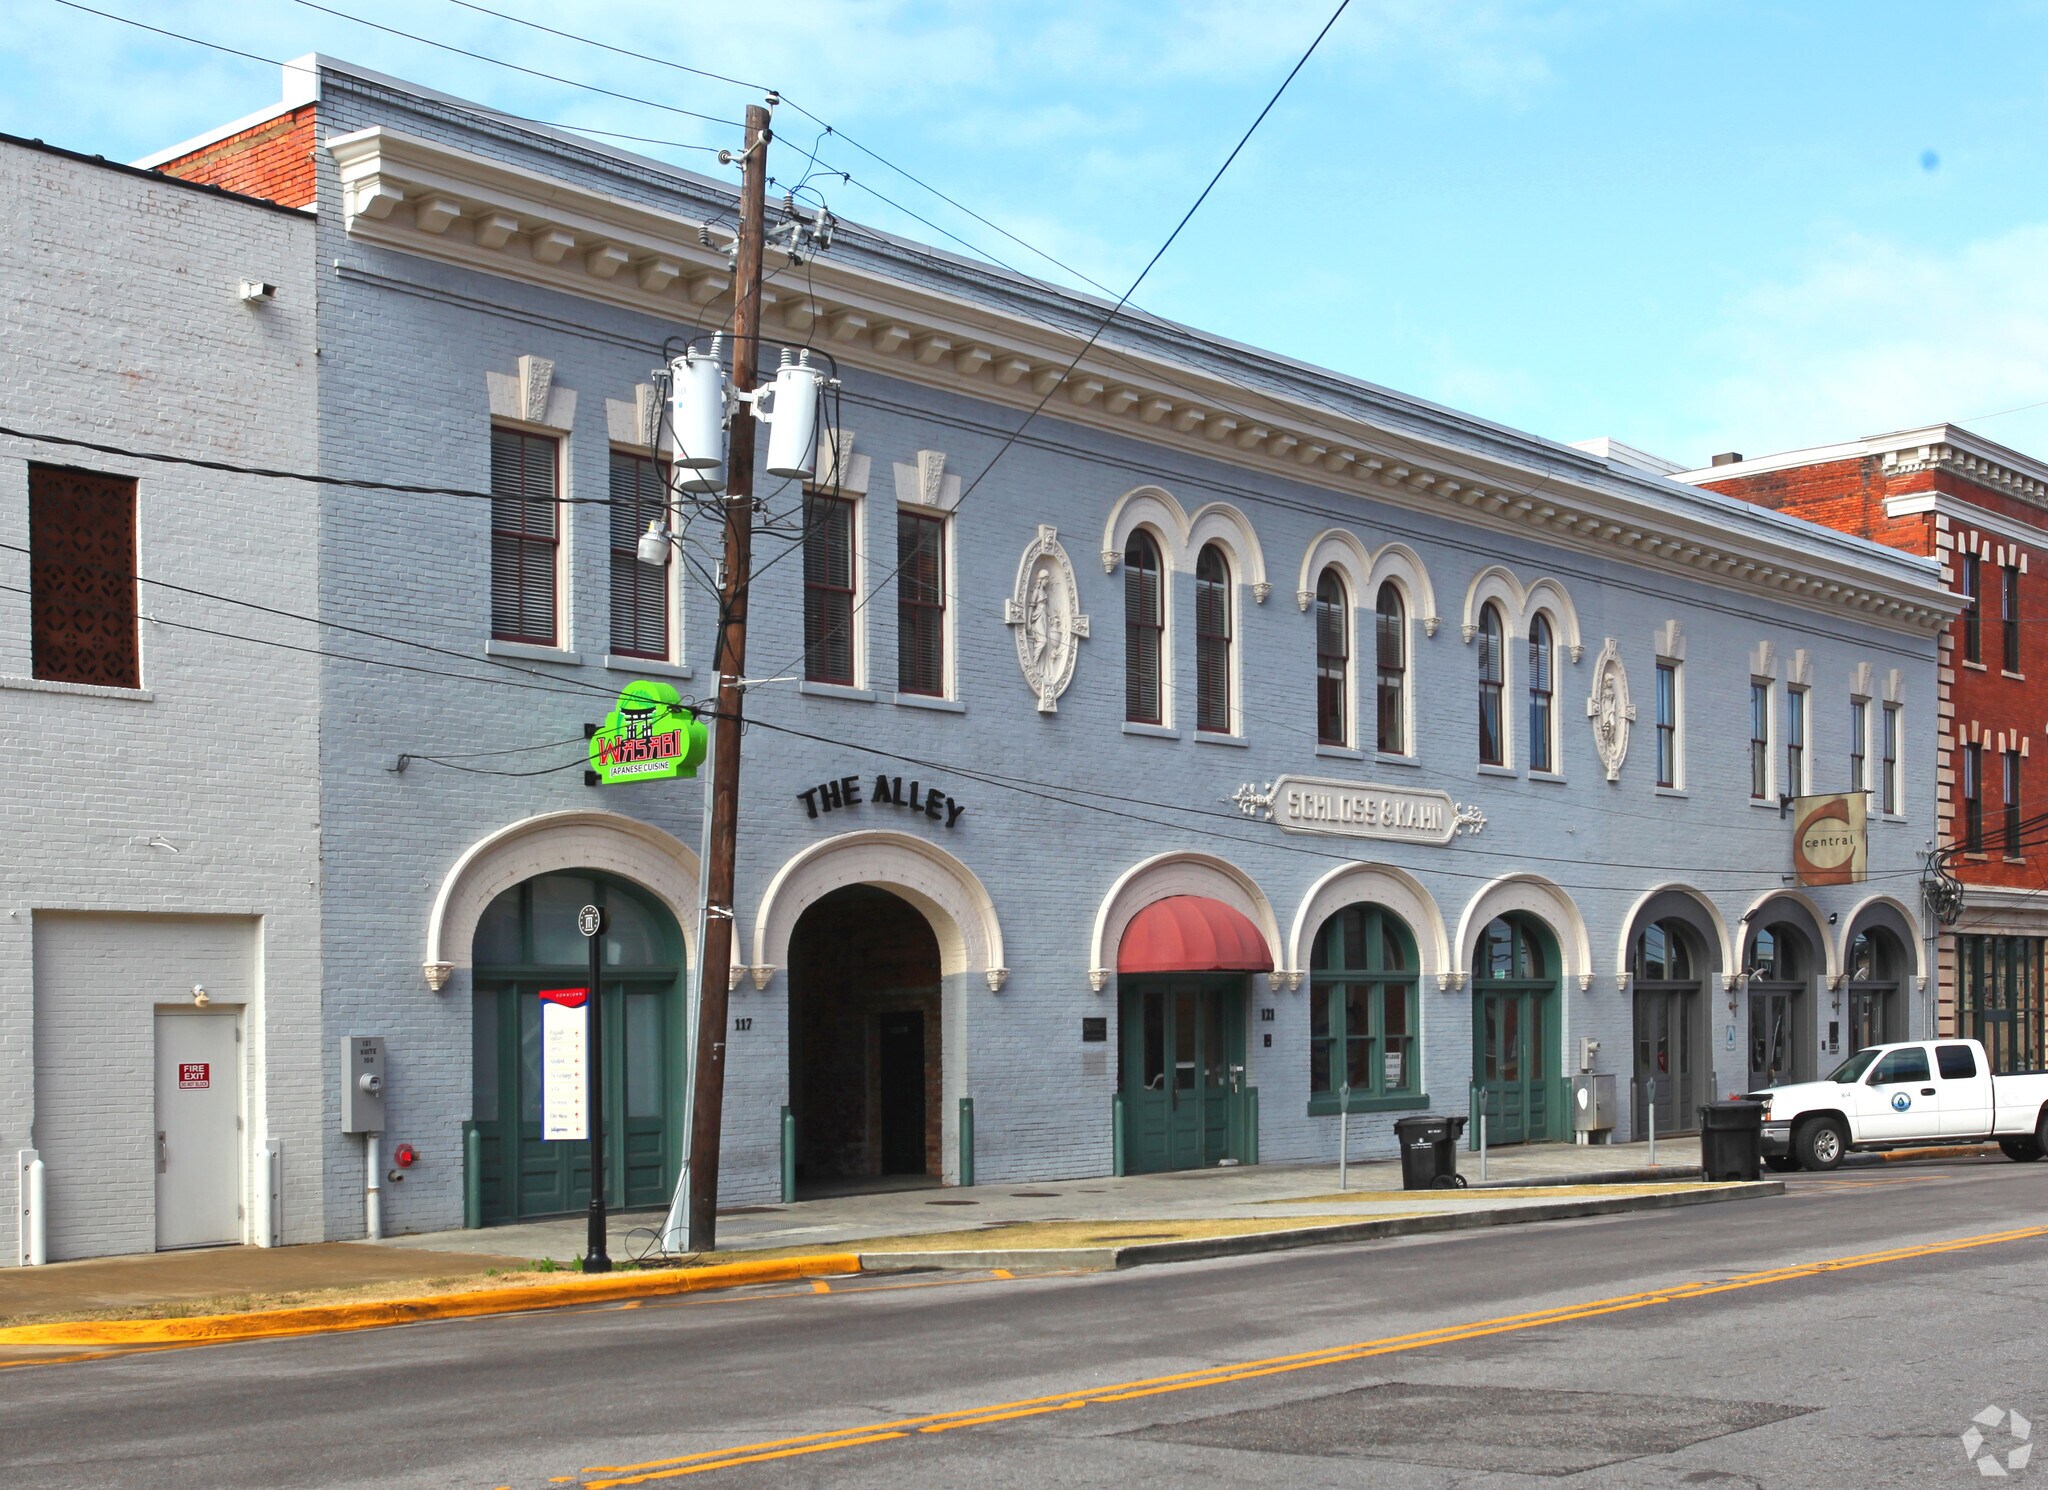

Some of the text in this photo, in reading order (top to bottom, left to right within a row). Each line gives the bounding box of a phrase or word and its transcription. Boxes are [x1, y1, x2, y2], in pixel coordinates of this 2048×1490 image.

[598, 730, 682, 766] WASABI
[610, 761, 669, 777] JAPANESE CUISINE
[796, 774, 966, 828] THE ALLEY
[1287, 789, 1443, 832] SCHLOSS & KAHN
[1804, 834, 1854, 848] central
[1261, 1008, 1275, 1021] 121
[735, 1017, 753, 1031] 117
[183, 1064, 205, 1073] FIRE
[184, 1072, 205, 1080] EXIT
